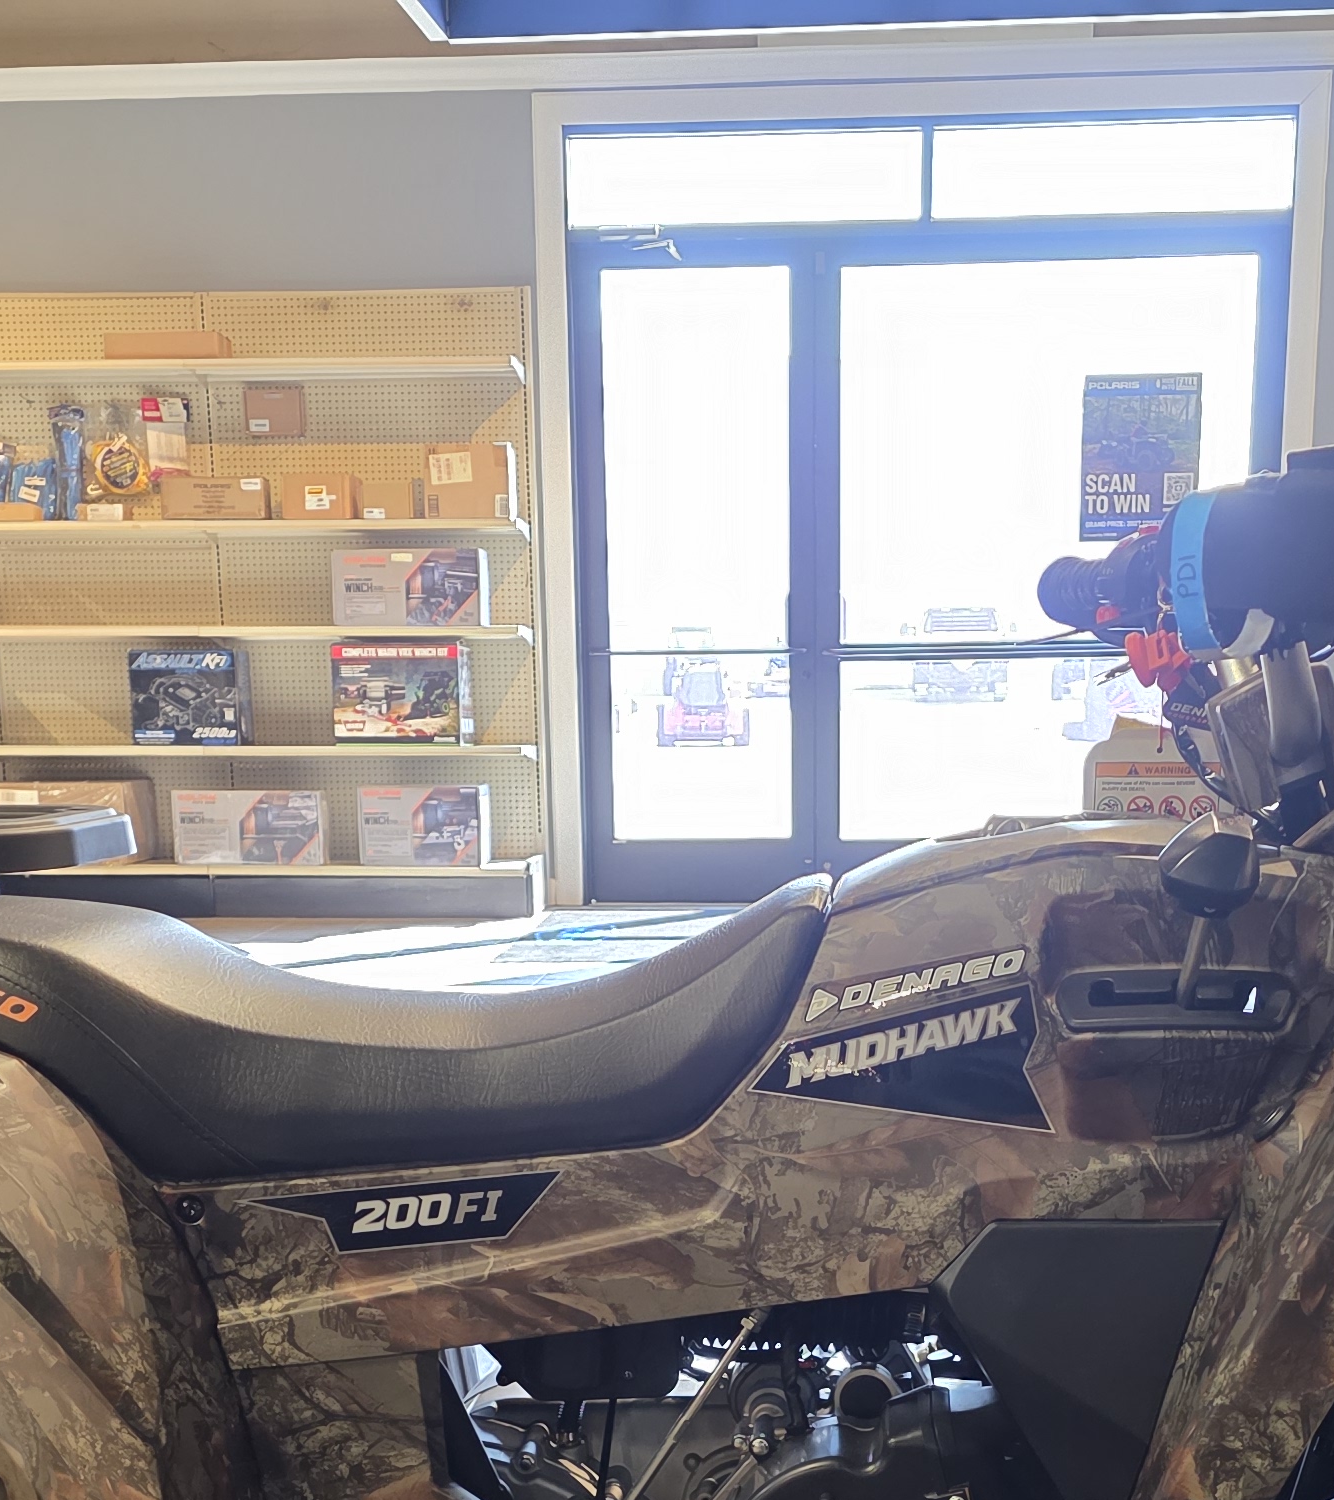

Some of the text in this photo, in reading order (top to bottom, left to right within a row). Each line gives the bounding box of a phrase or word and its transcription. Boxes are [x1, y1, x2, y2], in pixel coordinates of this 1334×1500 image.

[1088, 381, 1140, 390] POLARIS
[1177, 377, 1196, 387] FALL
[1085, 473, 1136, 493] SCAN
[1085, 494, 1150, 514] TO WIN
[1178, 554, 1197, 600] PDI
[344, 582, 374, 593] WINCH
[1144, 766, 1192, 775] WARNING
[838, 949, 1027, 1012] DENAGO
[785, 997, 1024, 1090] MUDHAWK
